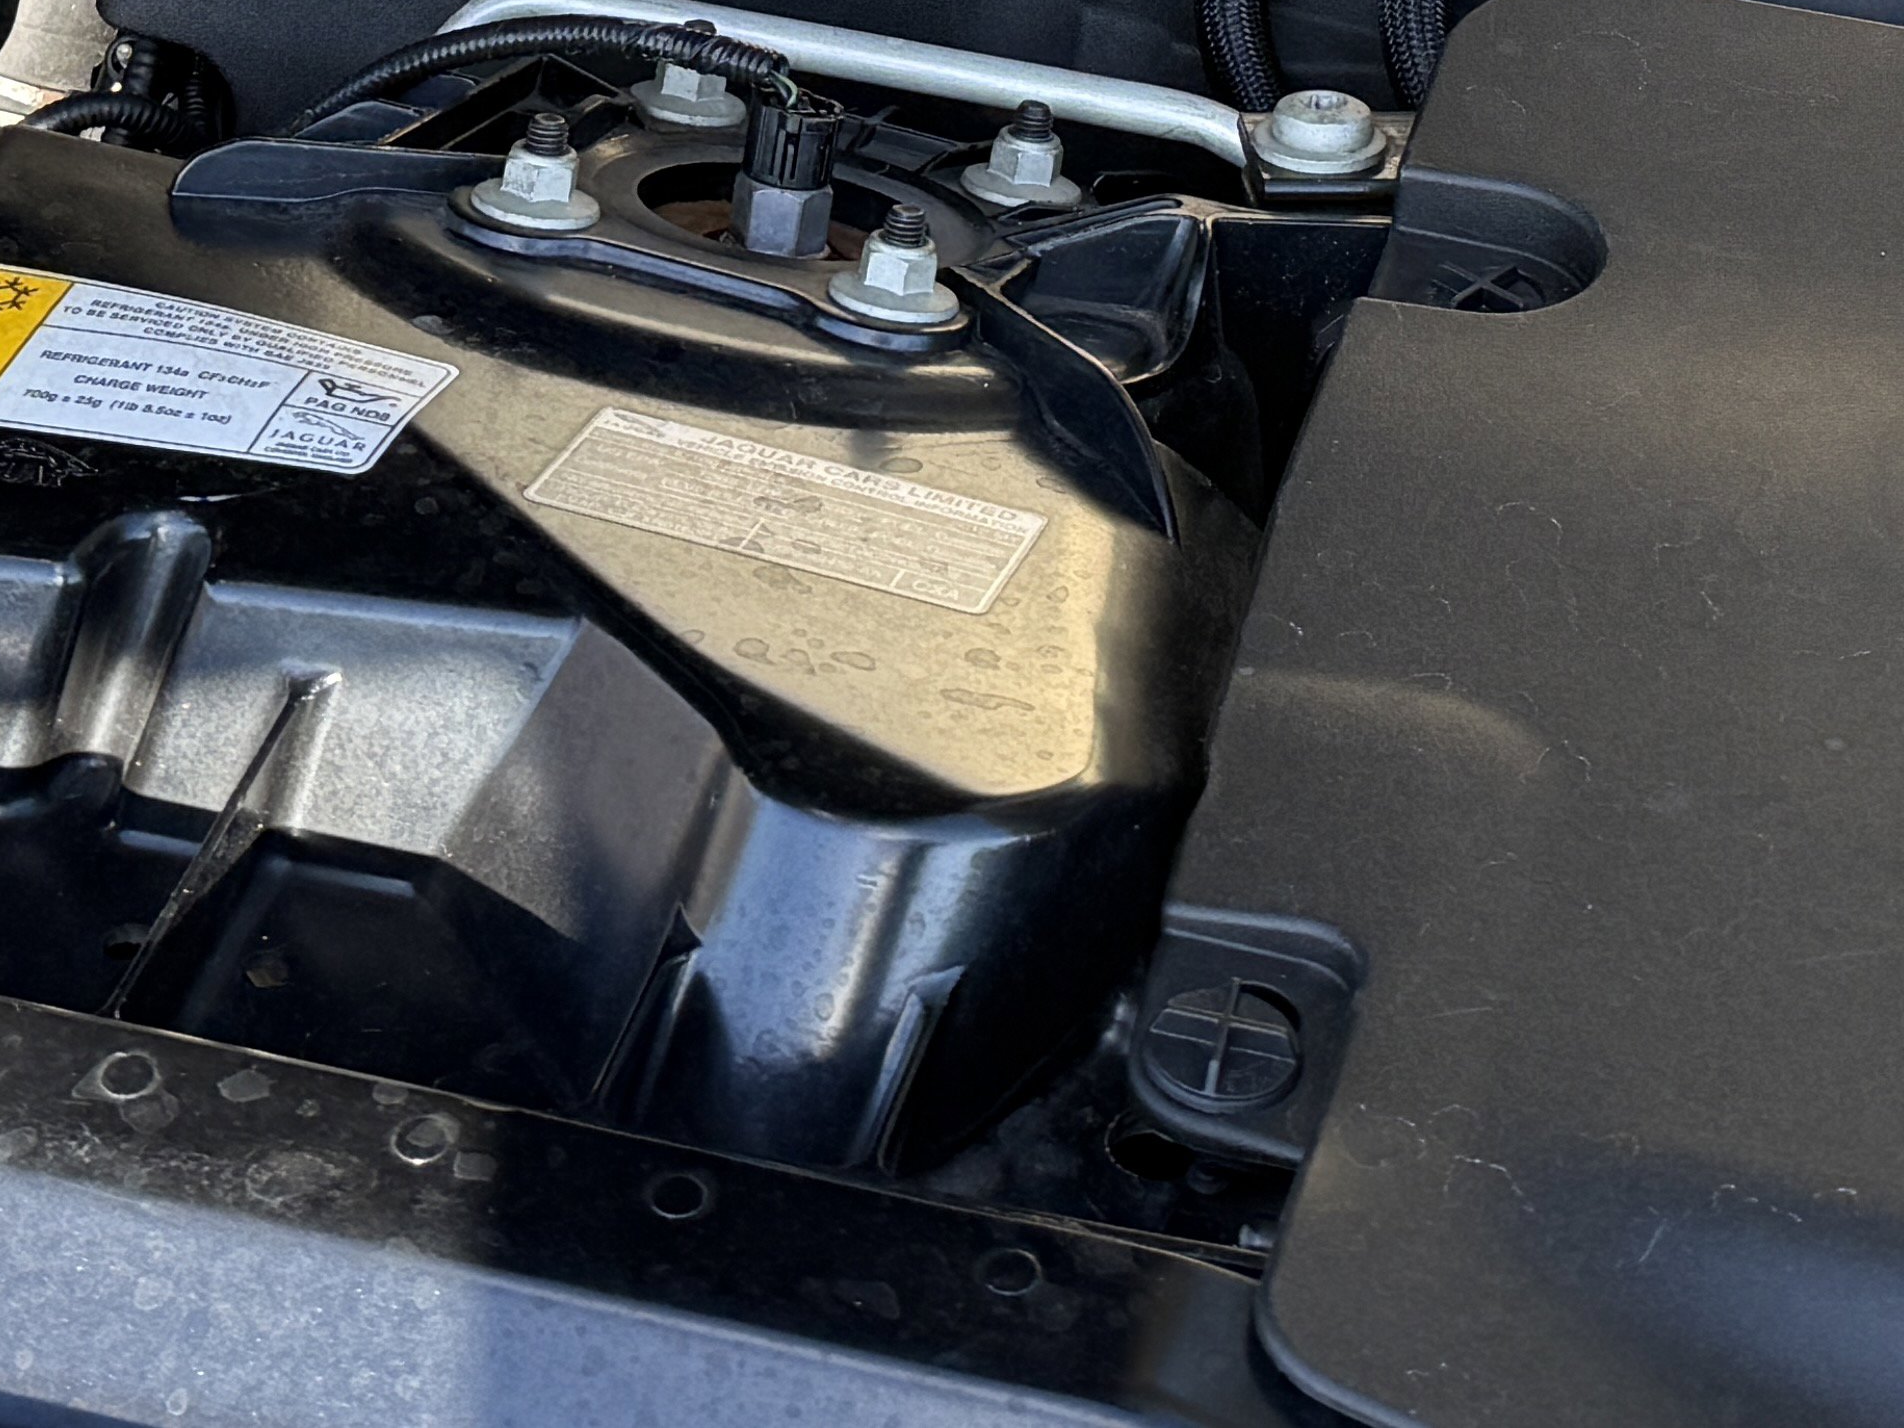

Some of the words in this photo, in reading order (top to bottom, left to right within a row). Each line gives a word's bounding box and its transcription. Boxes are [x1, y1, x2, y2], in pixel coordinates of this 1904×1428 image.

[63, 305, 82, 315] TO
[86, 309, 106, 318] BE
[40, 349, 152, 372] REFRIGERANT
[74, 374, 142, 392] CHARGE
[146, 383, 209, 400] WEIGHT
[304, 396, 348, 412] PAG
[268, 428, 366, 452] JAGUAR
[701, 436, 818, 470] JAGUAR
[824, 465, 901, 491] CARS
[907, 486, 1017, 521] LIMITED
